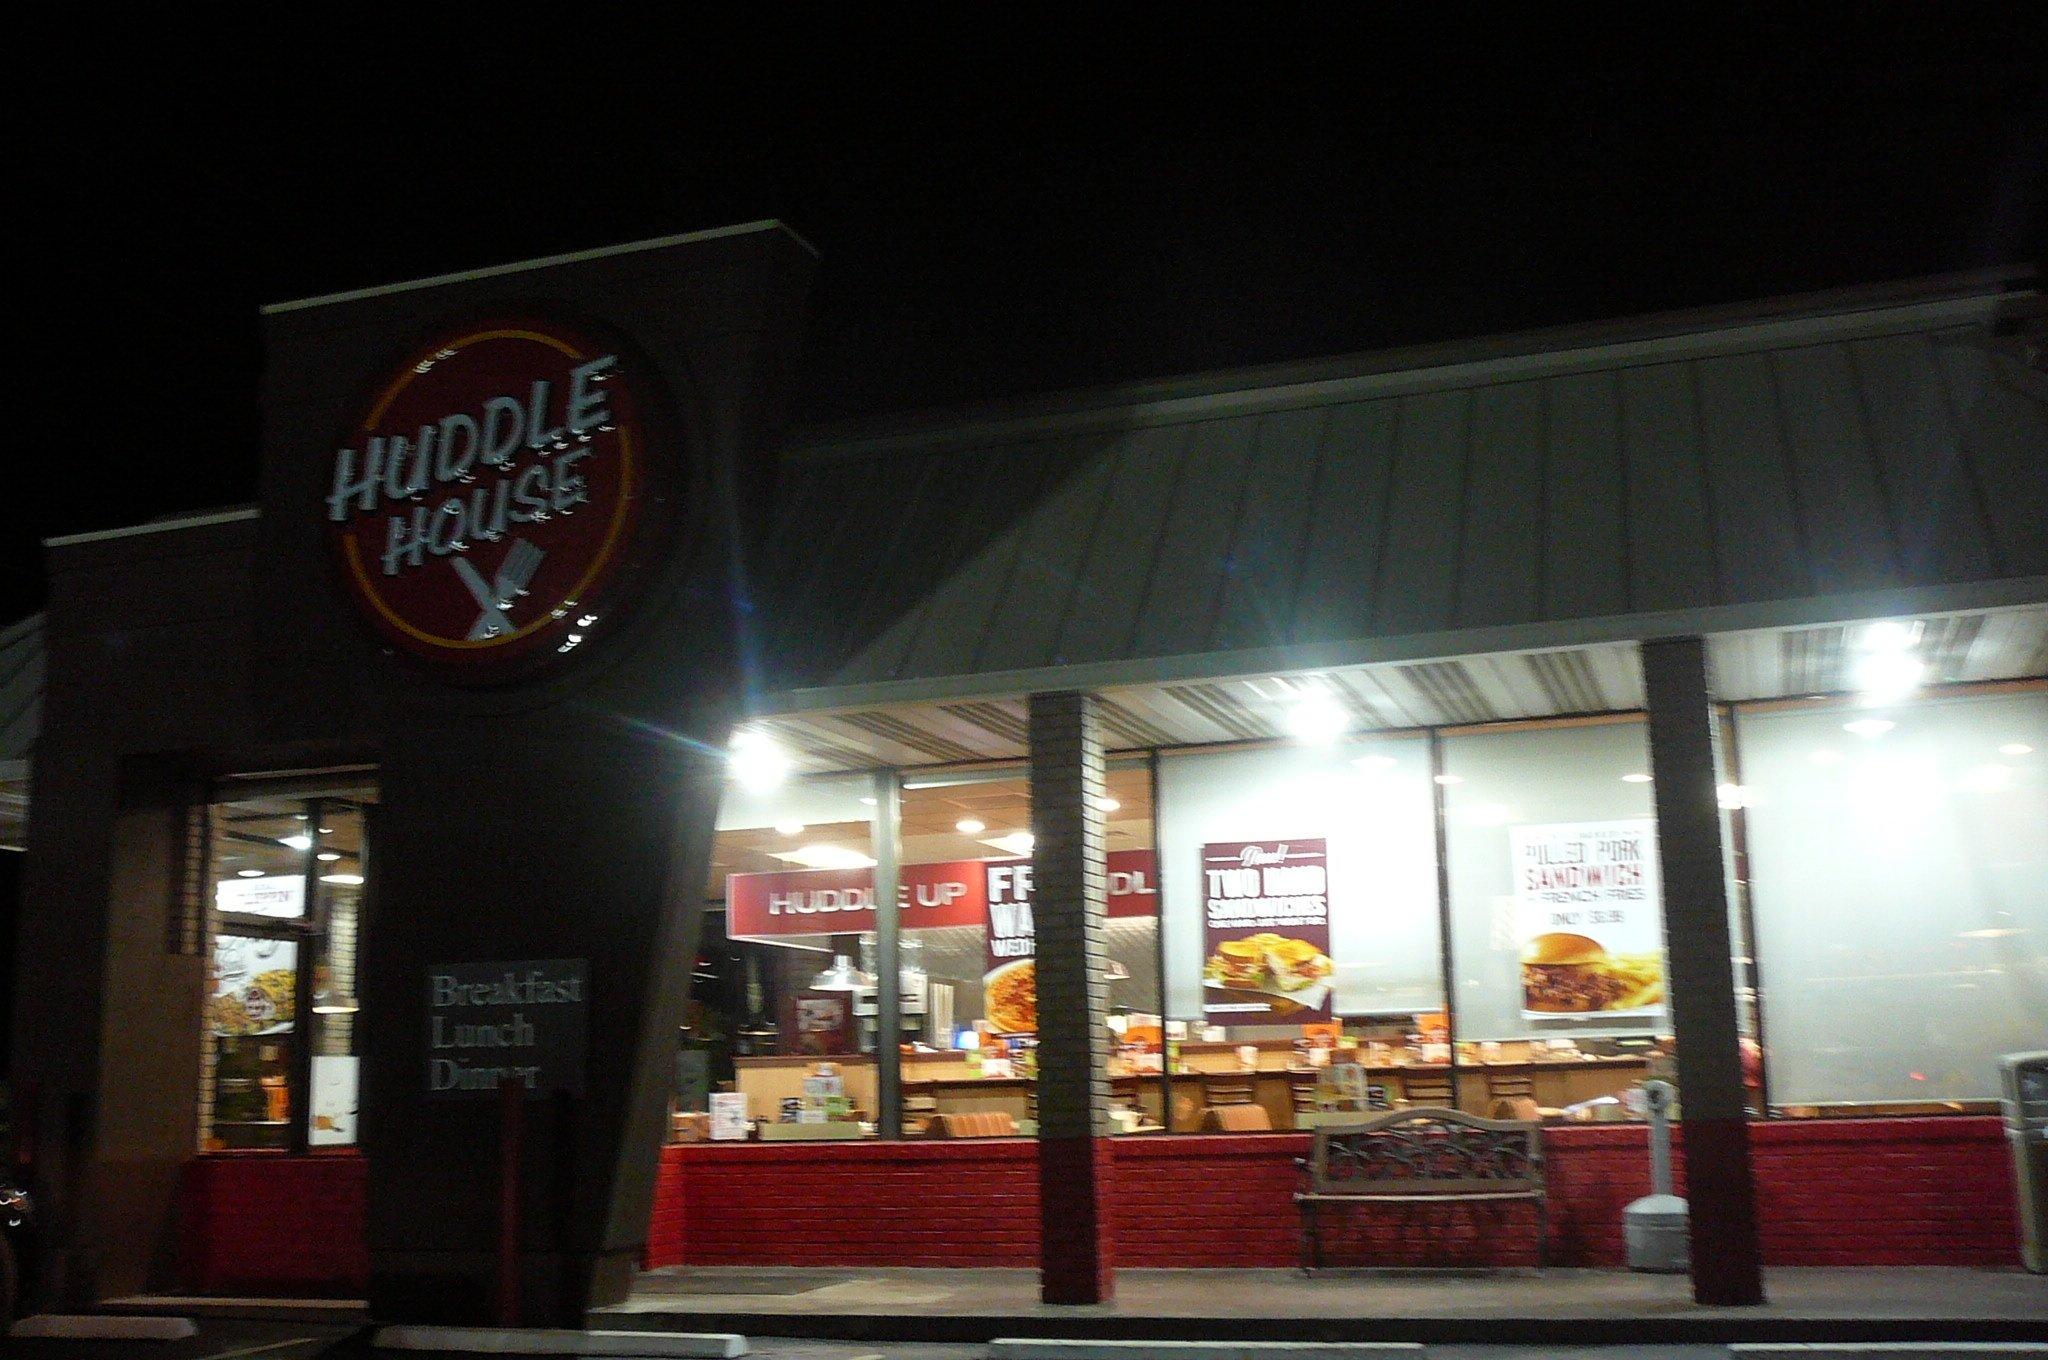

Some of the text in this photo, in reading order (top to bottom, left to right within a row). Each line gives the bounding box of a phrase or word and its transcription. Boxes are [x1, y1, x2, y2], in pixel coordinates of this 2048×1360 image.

[327, 353, 620, 521] HUDDLE
[380, 447, 593, 576] HOUSE
[1598, 838, 1641, 861] PORK
[1205, 869, 1261, 899] TWO
[1524, 863, 1643, 890] SANDWICH
[917, 882, 968, 907] UP
[431, 970, 583, 1007] Breakfast
[431, 1012, 535, 1050] Lunch
